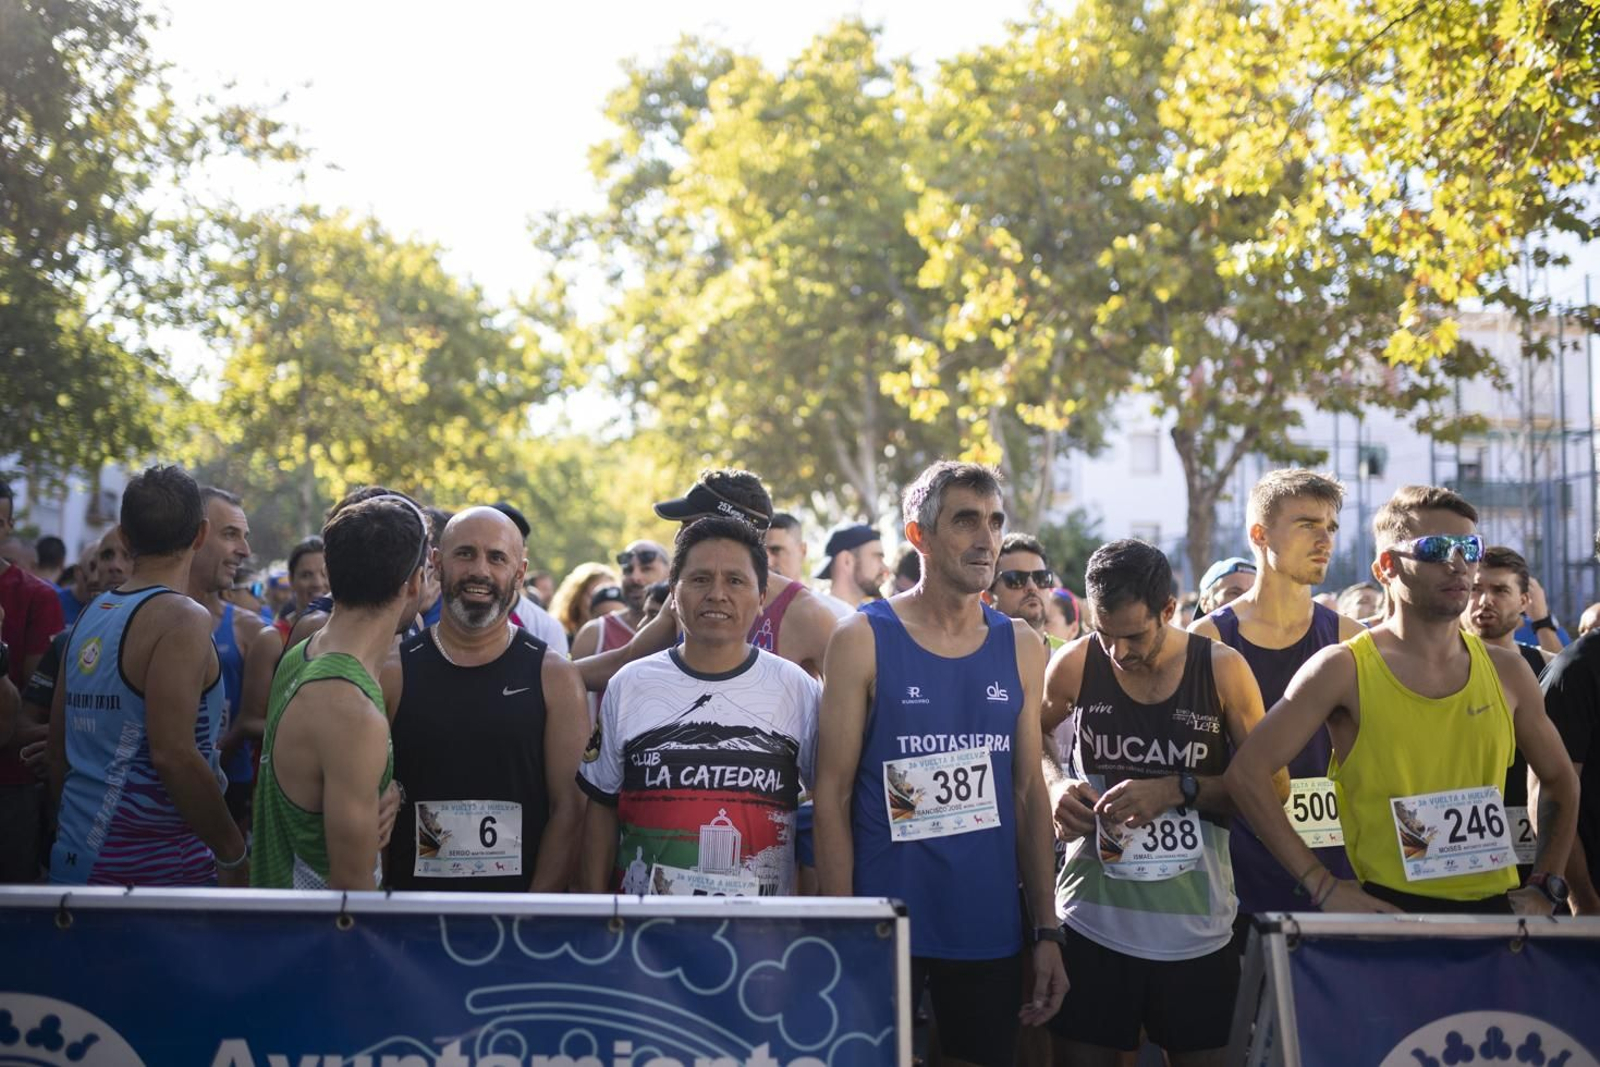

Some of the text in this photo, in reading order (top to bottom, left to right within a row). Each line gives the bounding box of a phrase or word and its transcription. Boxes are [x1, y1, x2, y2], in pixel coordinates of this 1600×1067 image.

[1089, 702, 1113, 714] vive
[631, 751, 661, 767] CLUB
[897, 733, 1010, 753] TROTASIERRA
[645, 765, 784, 793] LA CATEDRAL
[933, 763, 988, 805] 387
[1293, 791, 1339, 823] 500
[479, 816, 498, 848] 6
[1141, 819, 1198, 852] 388
[1443, 803, 1504, 844] 246
